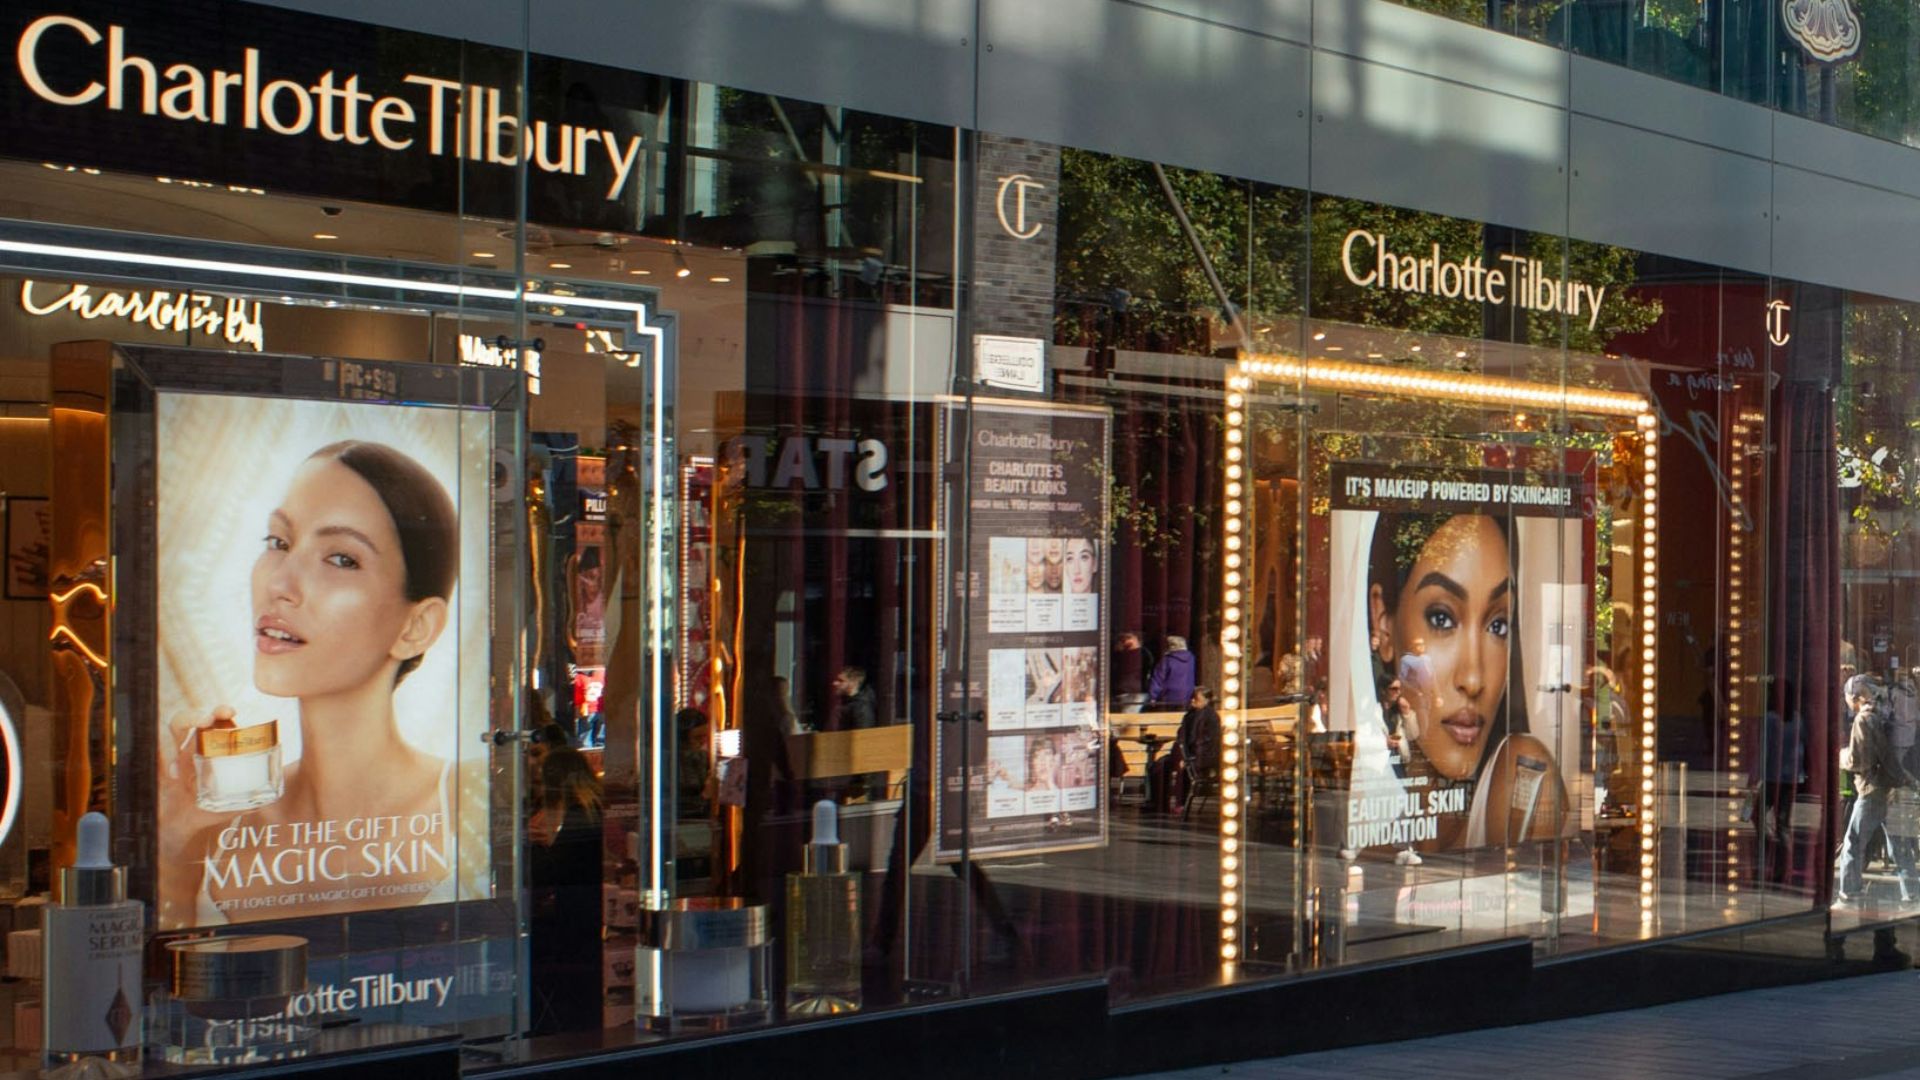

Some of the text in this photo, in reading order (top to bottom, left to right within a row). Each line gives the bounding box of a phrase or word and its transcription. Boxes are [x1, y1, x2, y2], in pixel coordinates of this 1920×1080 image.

[984, 477, 1068, 496] BEAUTY LOOKS
[988, 460, 1064, 479] CHARLOTTE'S
[1345, 476, 1371, 497] IT'S
[1374, 478, 1430, 499] MAKEUP
[1431, 480, 1490, 503] POWERED
[1492, 484, 1509, 503] BY
[1347, 788, 1466, 823] EAUTIFUL SKIN
[217, 811, 443, 851] GIVE THE GIFT OF
[1347, 815, 1438, 850] OUNDATION
[202, 834, 455, 892] MAGIC SKIN
